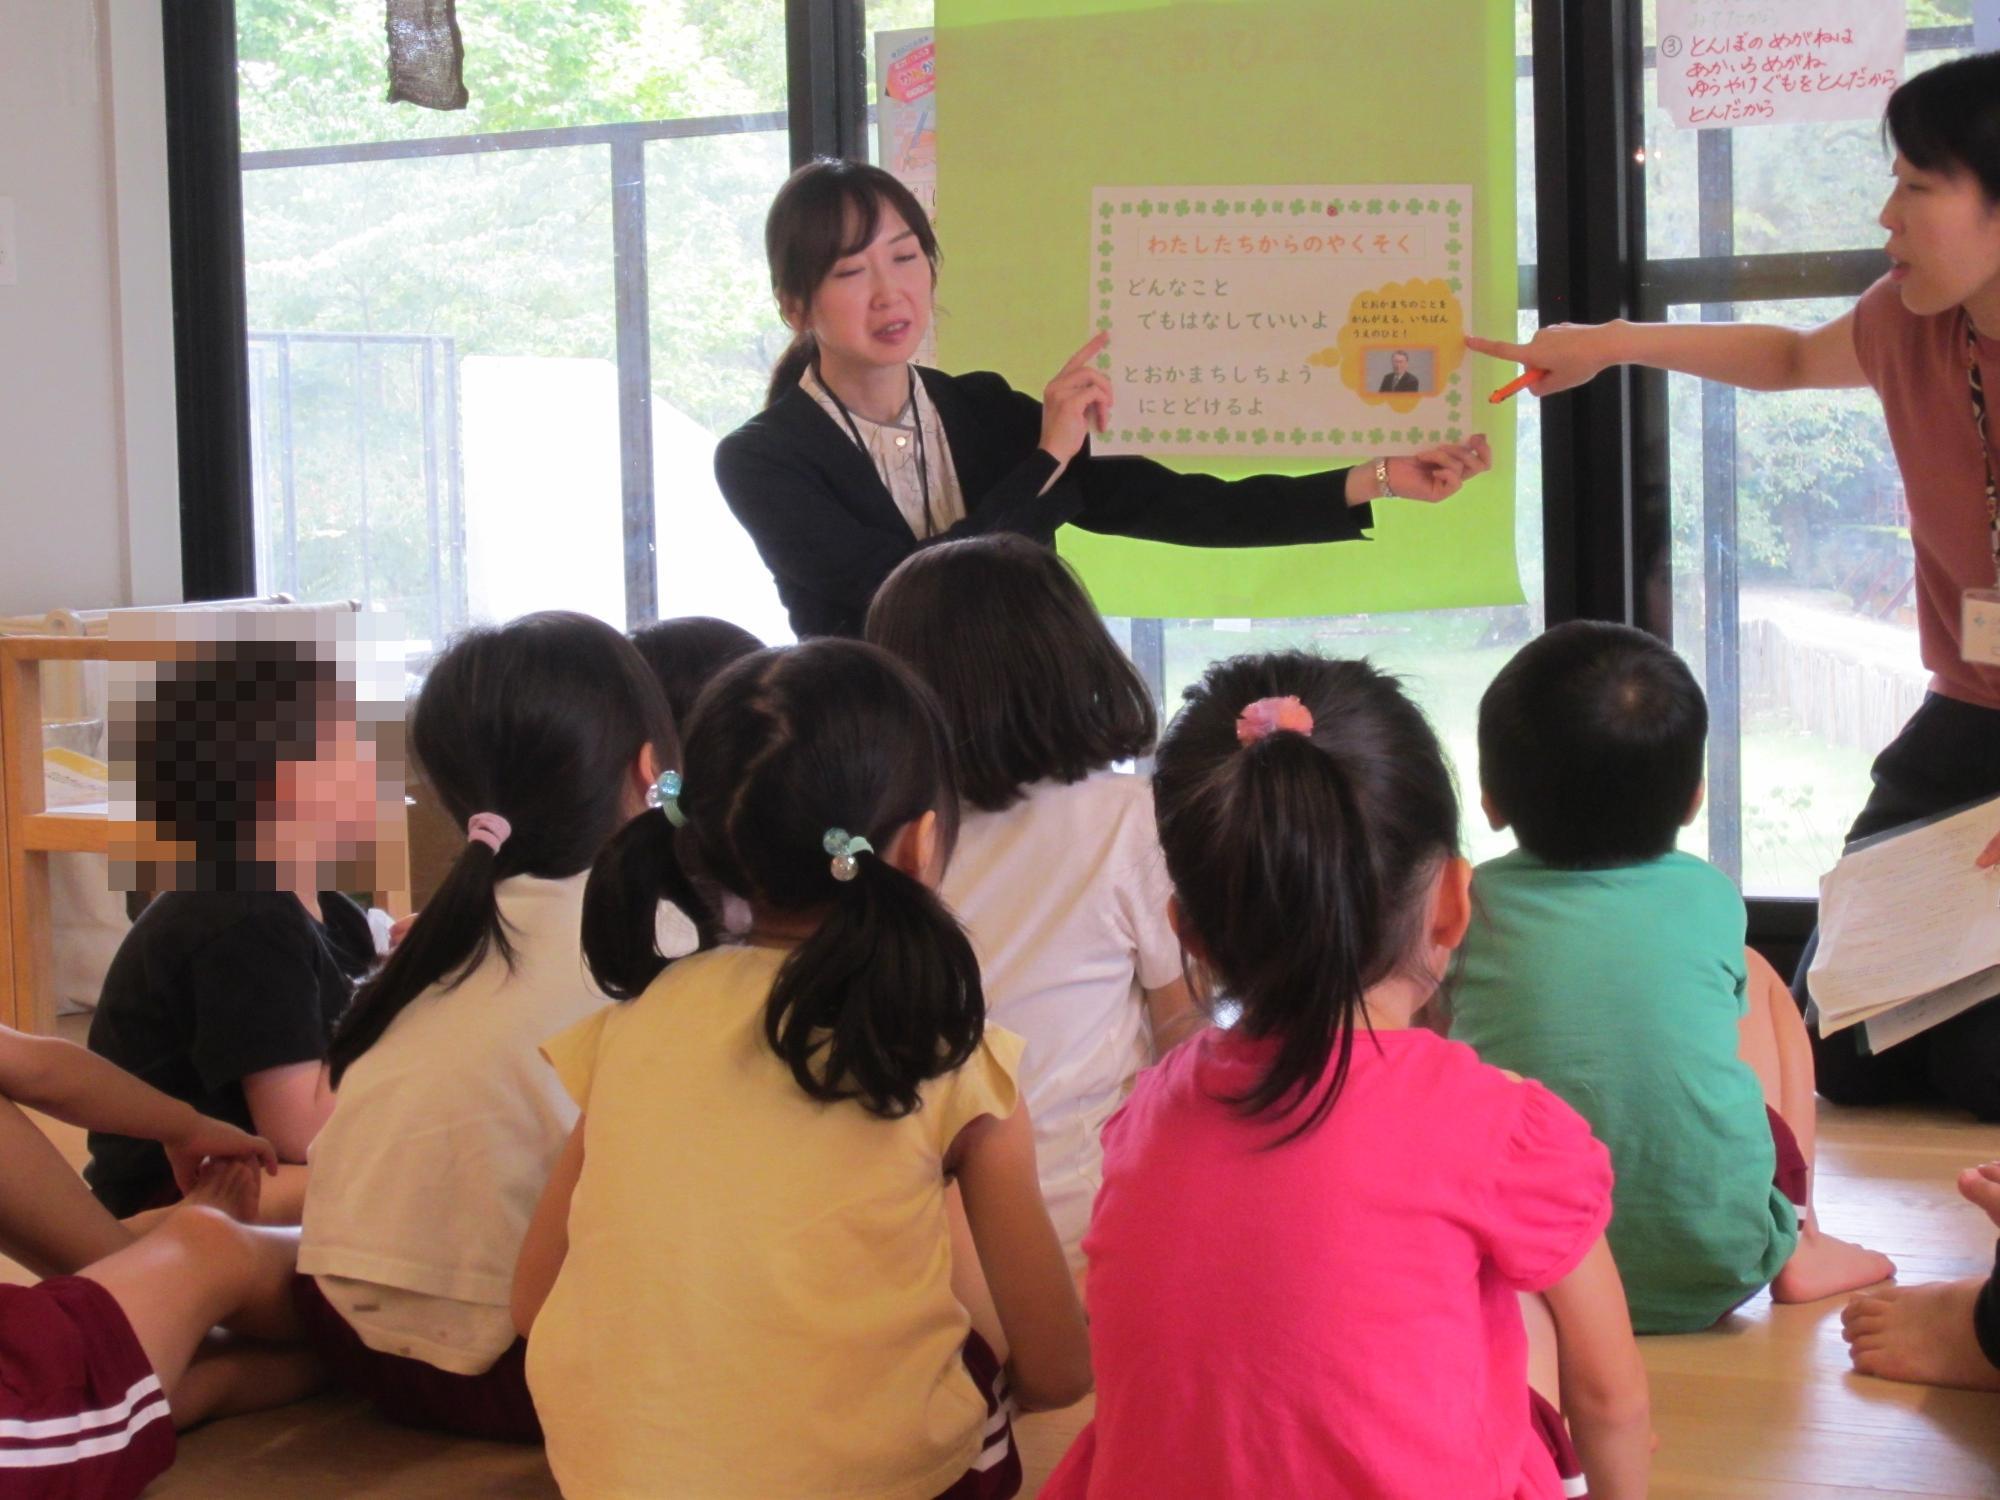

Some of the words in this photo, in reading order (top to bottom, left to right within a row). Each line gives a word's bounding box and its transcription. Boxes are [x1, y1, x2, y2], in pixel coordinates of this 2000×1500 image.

[1689, 99, 1775, 123] とんだから
[1147, 233, 1411, 255] わたしたちからのやくそく
[1128, 277, 1229, 297] どんなこと
[1138, 311, 1329, 330] でもはなしていいよ
[1124, 365, 1313, 385] とおかまちしちょう
[1138, 397, 1265, 416] にとどけるよ
